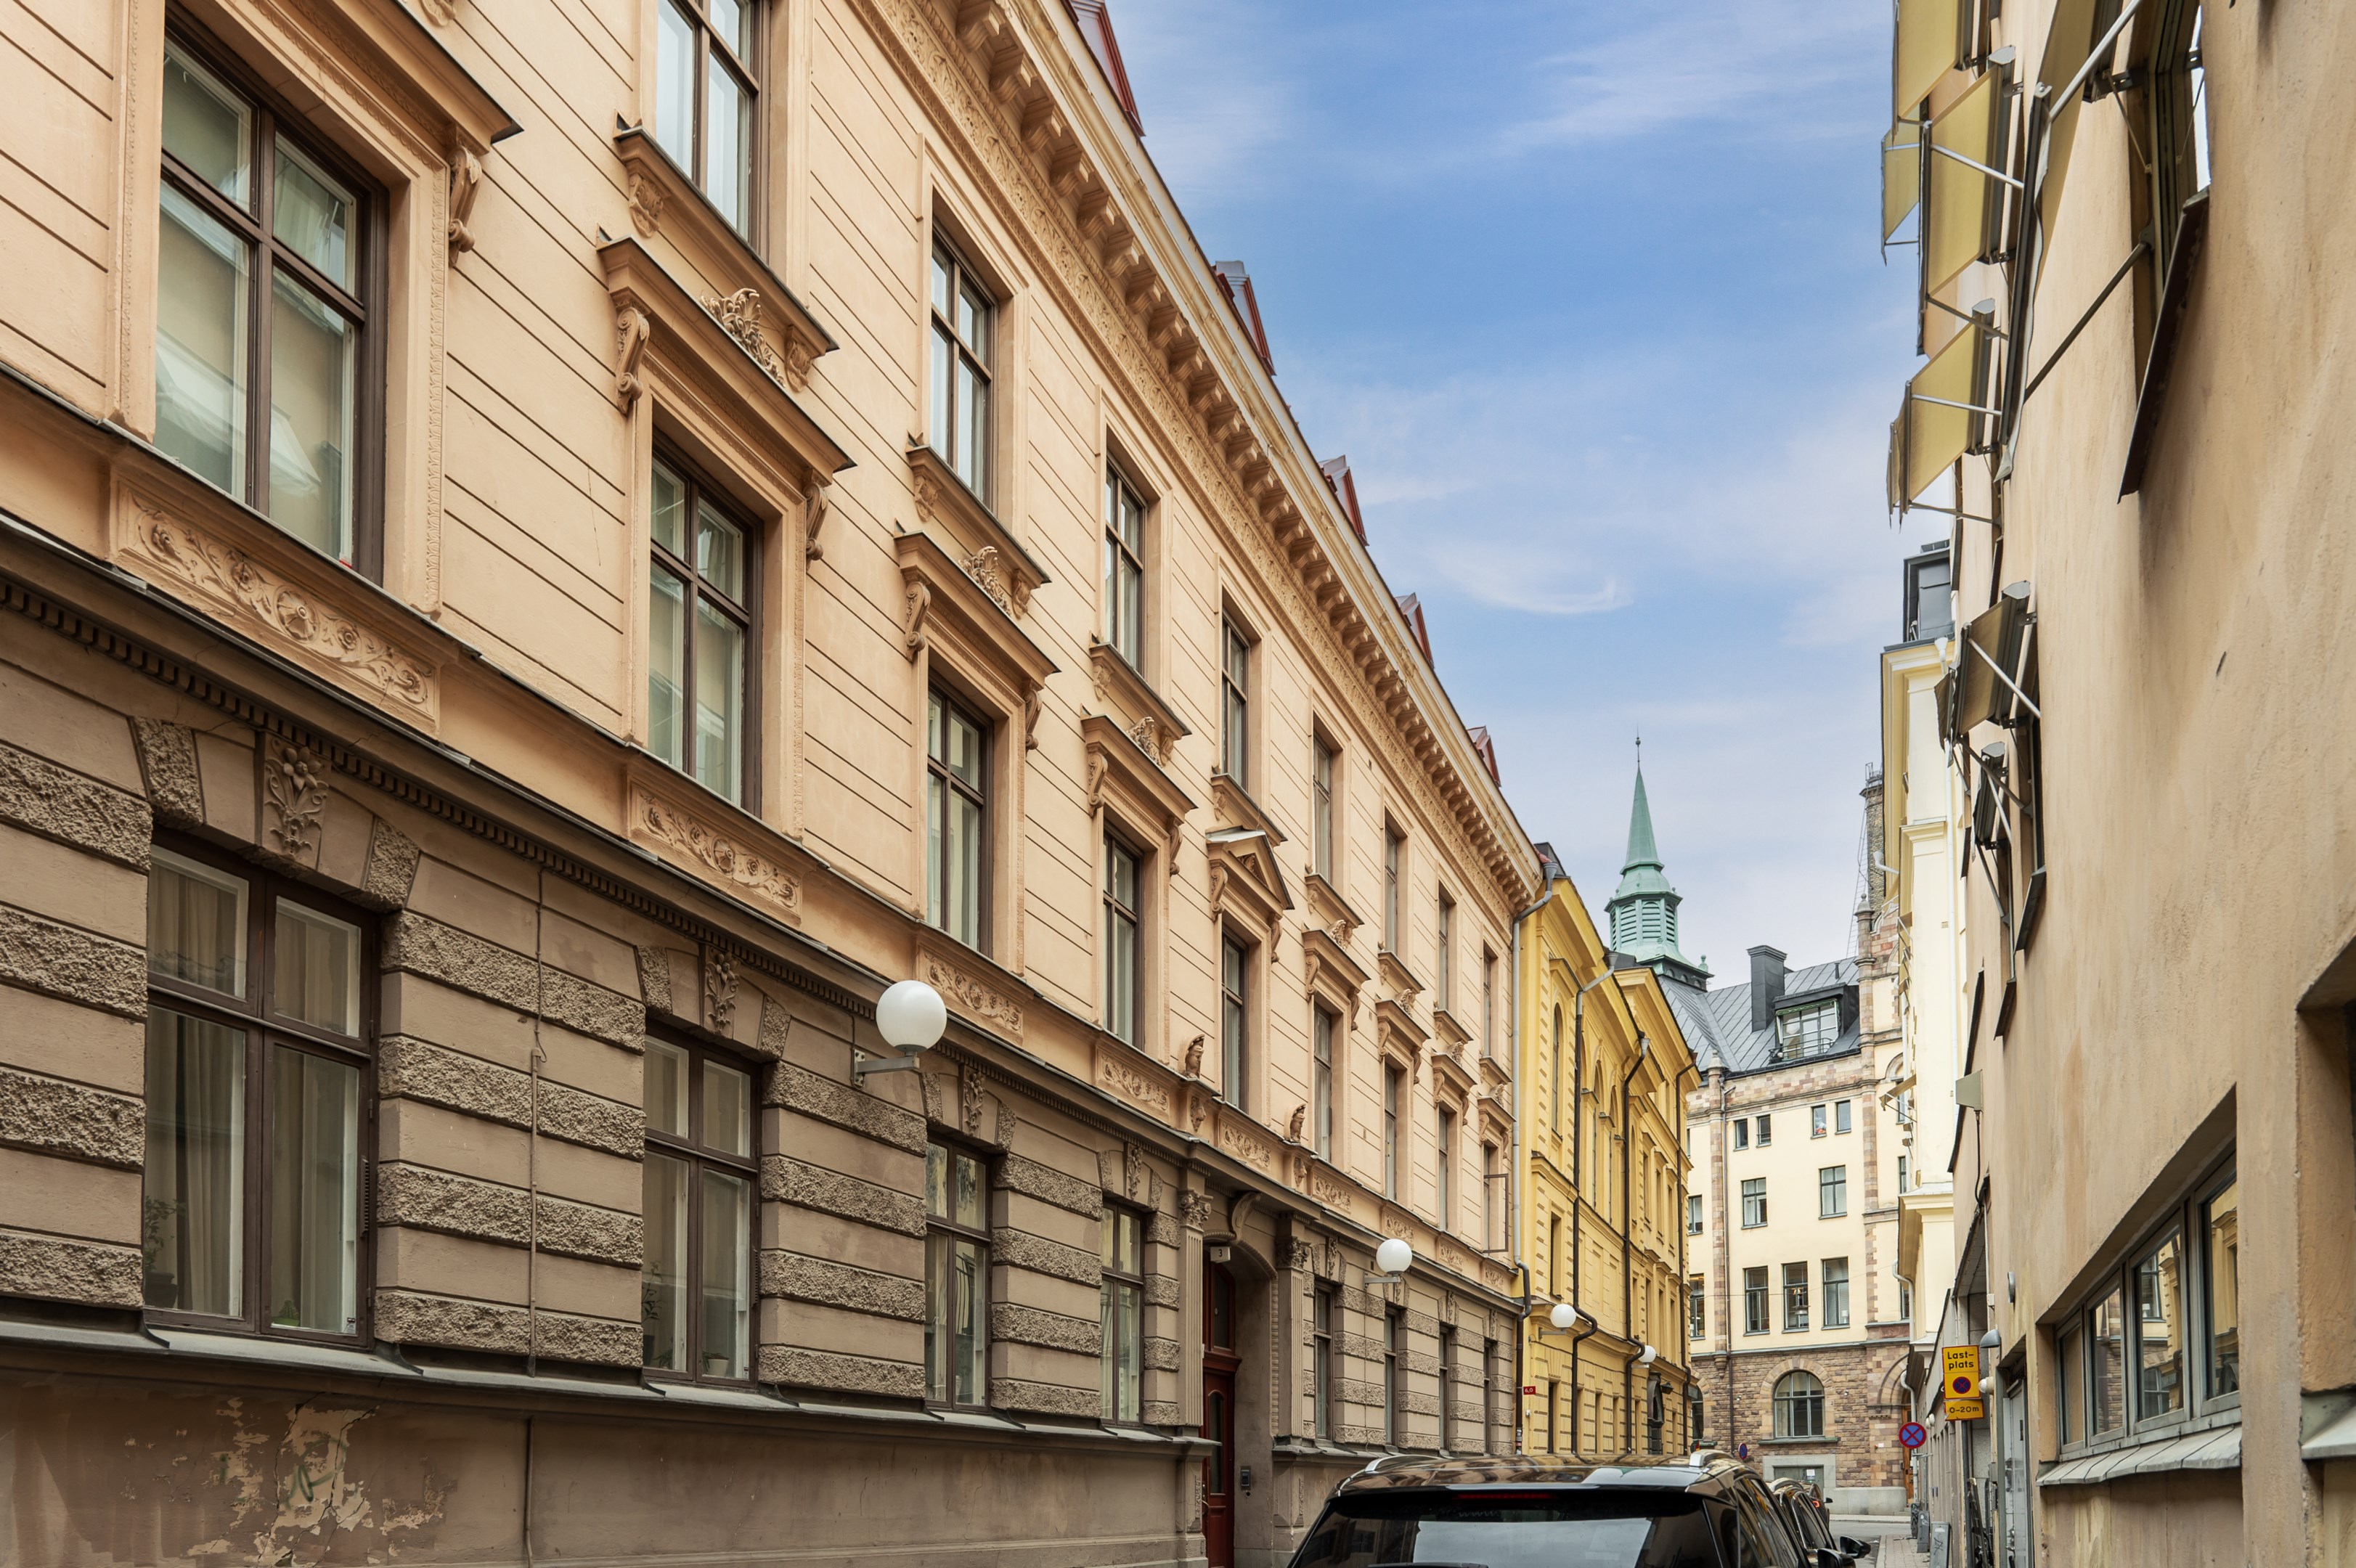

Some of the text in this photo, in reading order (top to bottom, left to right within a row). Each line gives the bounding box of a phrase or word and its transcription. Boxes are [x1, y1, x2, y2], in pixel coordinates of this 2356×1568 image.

[1218, 1249, 1223, 1257] 3
[1947, 1351, 1974, 1360] Last-
[1949, 1360, 1974, 1371] plats
